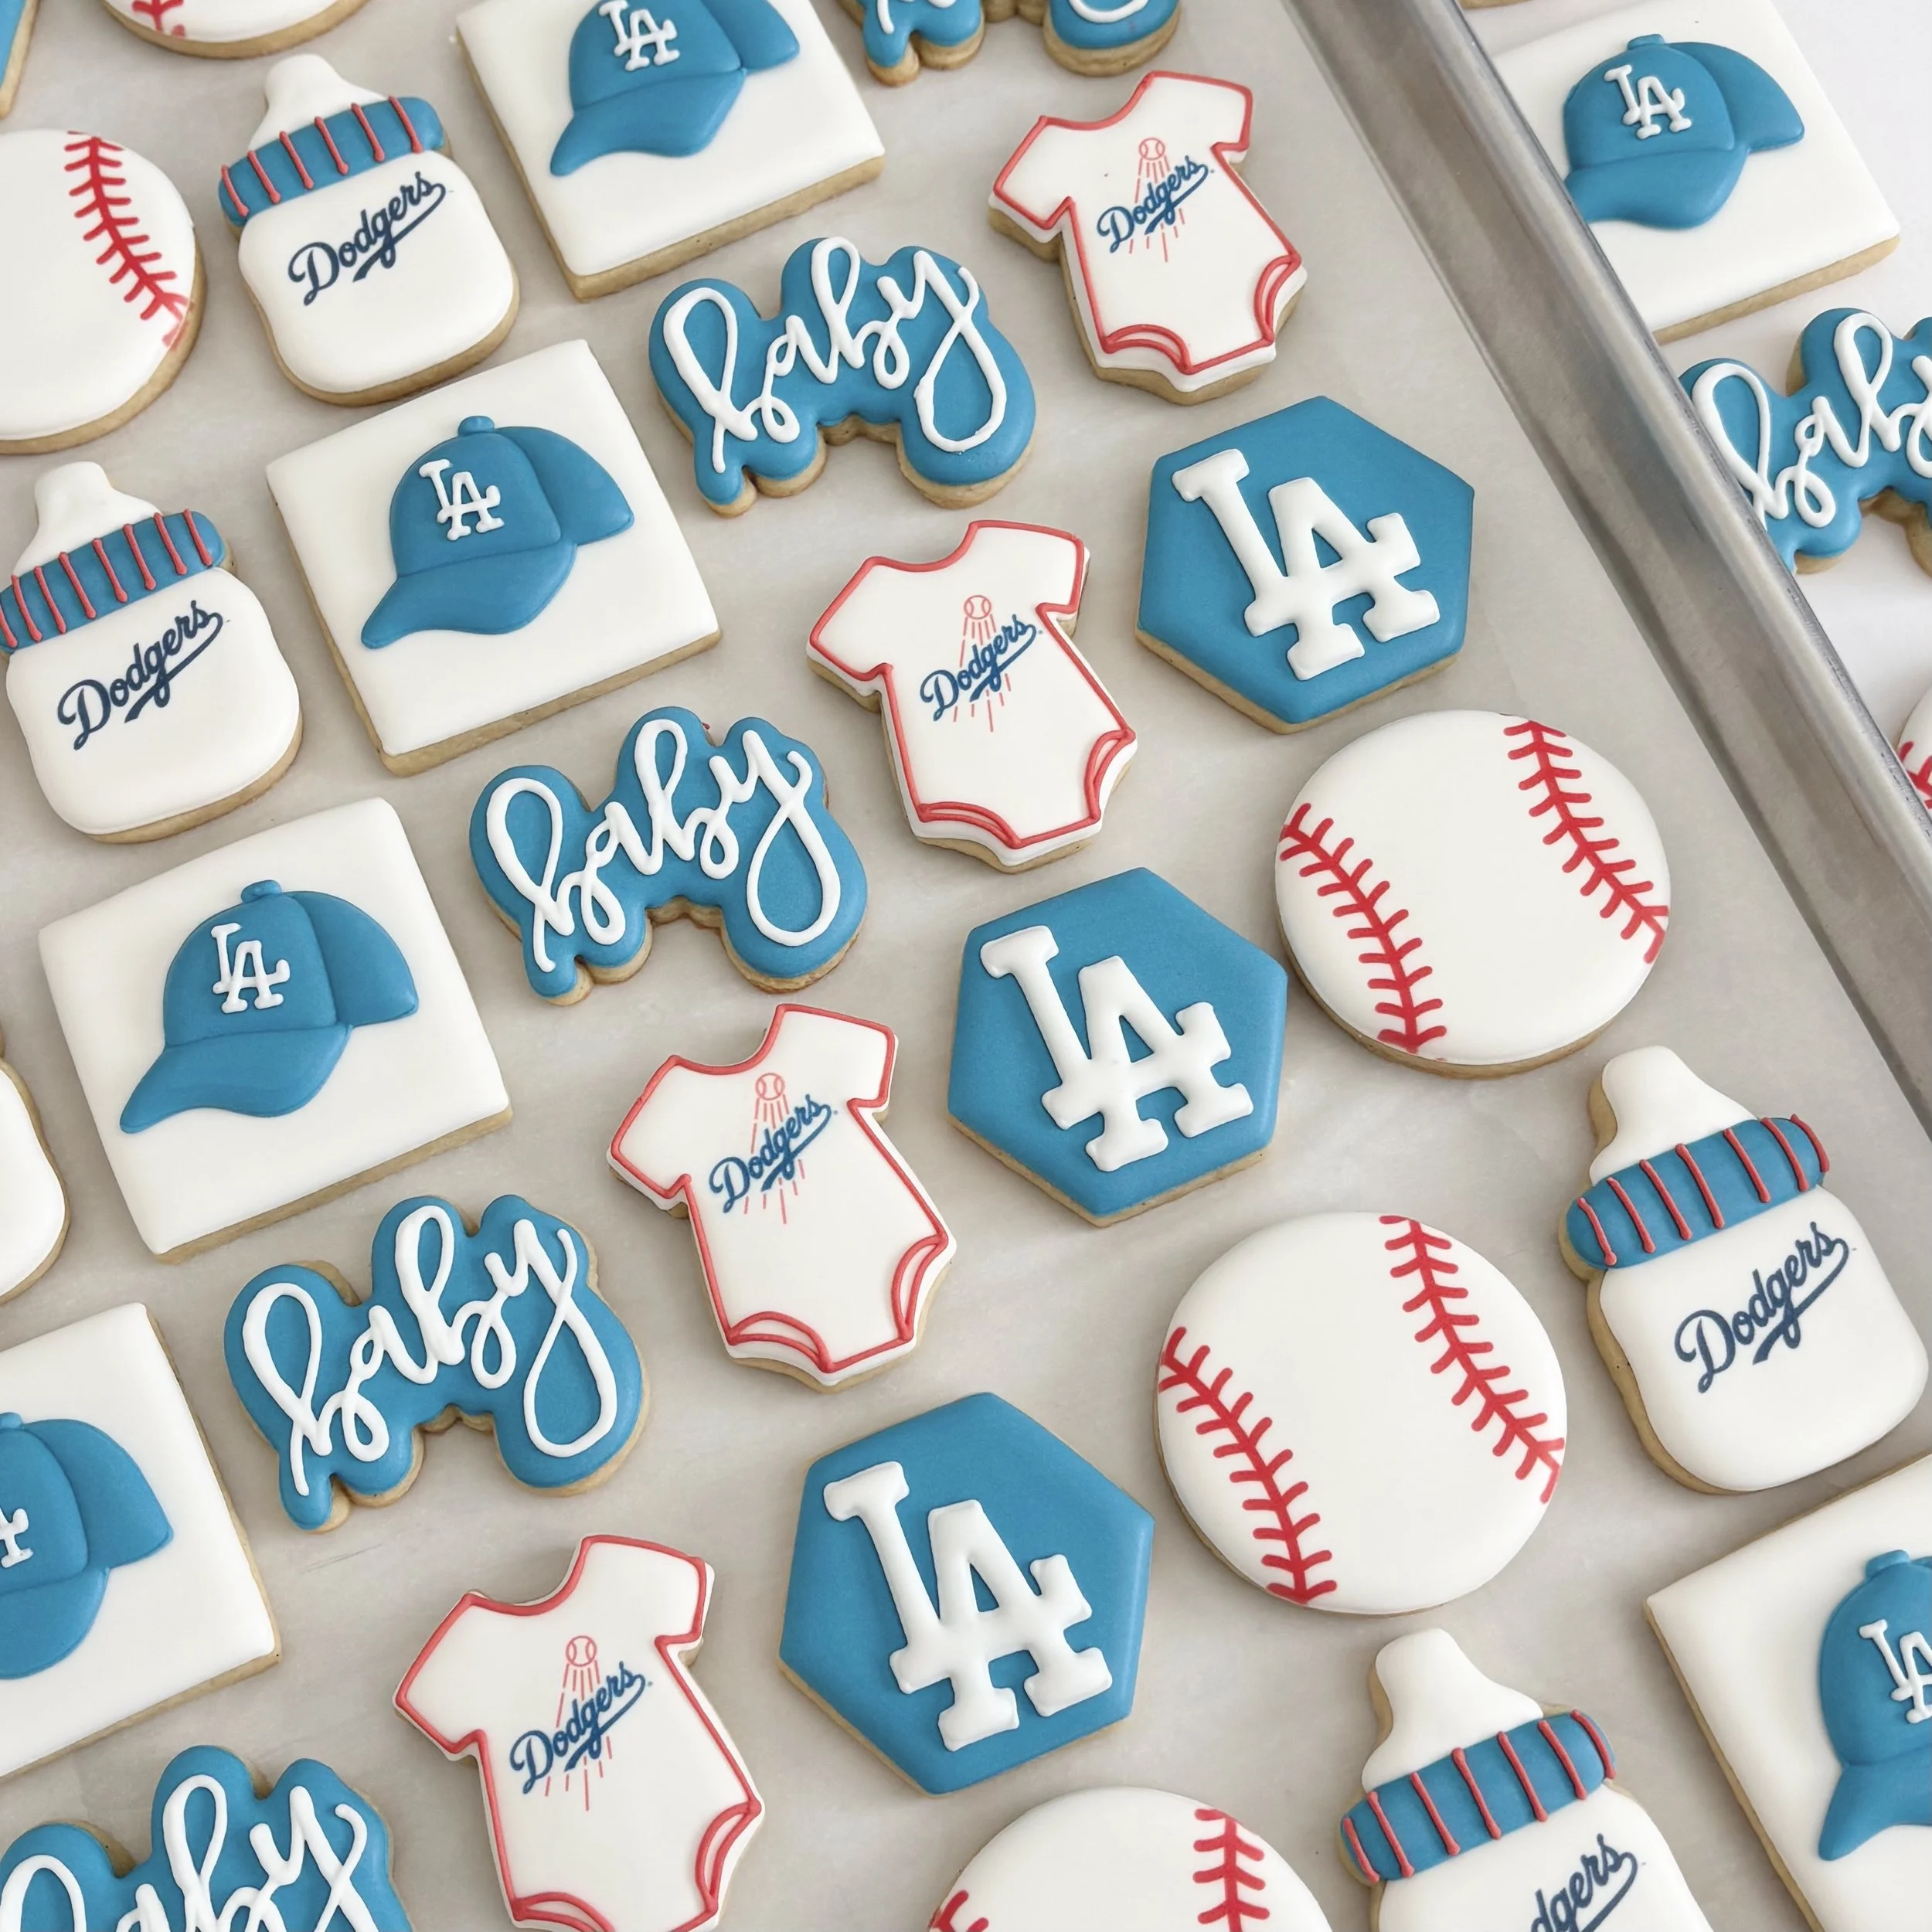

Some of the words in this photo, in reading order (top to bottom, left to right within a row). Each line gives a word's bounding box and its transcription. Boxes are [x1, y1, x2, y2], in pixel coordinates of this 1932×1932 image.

[599, 0, 680, 71] LA
[1604, 64, 1692, 139] LA
[288, 172, 446, 306] Dodgers
[1097, 156, 1209, 253] Dodgers
[663, 236, 1007, 473] baby
[1692, 312, 1932, 531] bab
[418, 458, 504, 541] LA
[1172, 448, 1440, 681] LA
[57, 600, 223, 750] Dodgers
[920, 614, 1037, 722] Dodgers
[486, 718, 842, 973] baby
[210, 922, 291, 1014] LA
[980, 925, 1254, 1172] LA
[709, 1094, 832, 1214] Dodgers
[242, 1205, 618, 1497] baby
[1675, 1223, 1849, 1393] Dodgers
[823, 1461, 1114, 1752] LA
[509, 1662, 646, 1795] Dodgers
[1531, 1833, 1638, 1932] dgers
